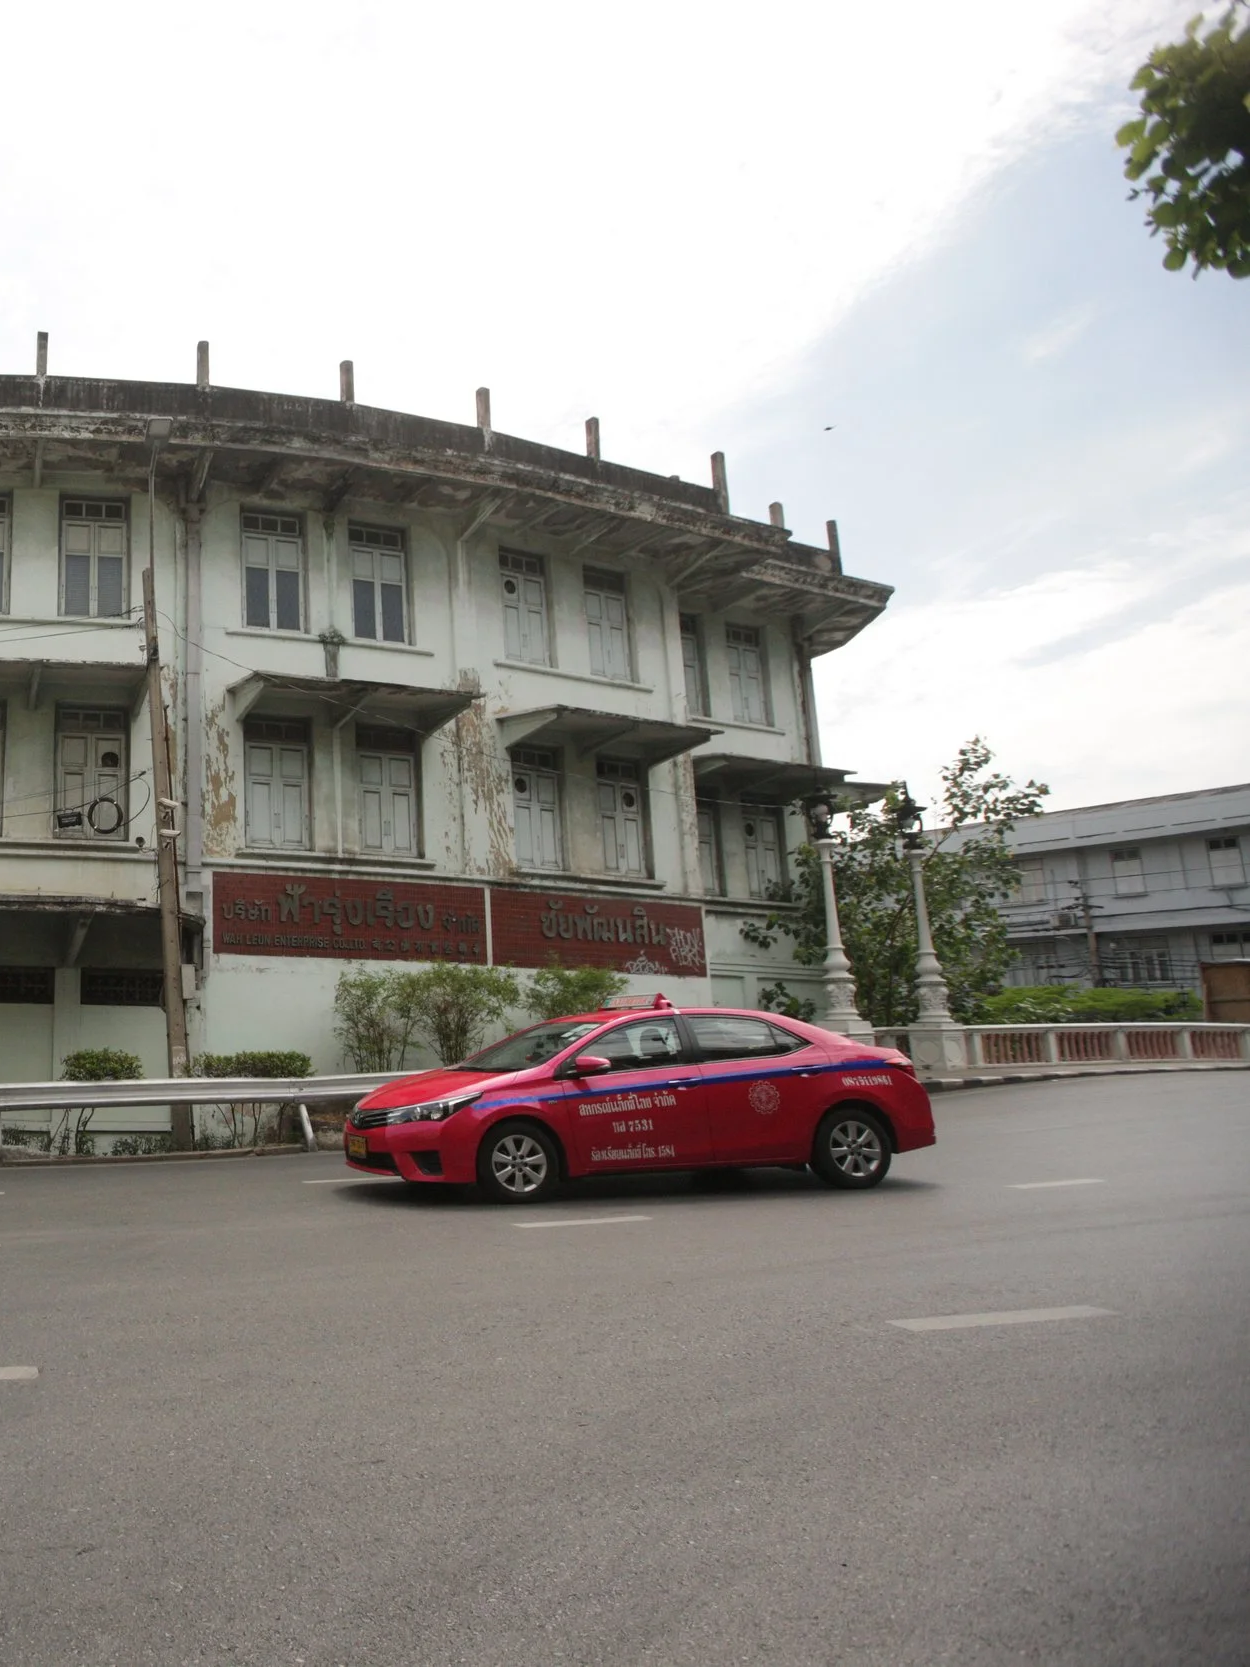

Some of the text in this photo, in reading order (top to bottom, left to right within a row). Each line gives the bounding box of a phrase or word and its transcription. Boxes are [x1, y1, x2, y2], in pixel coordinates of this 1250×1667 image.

[222, 898, 270, 920] บริษัท
[222, 932, 244, 945] WAH
[274, 935, 330, 949] ENTERPRISE
[628, 1119, 654, 1132] 7531
[658, 1144, 675, 1158] 1584
